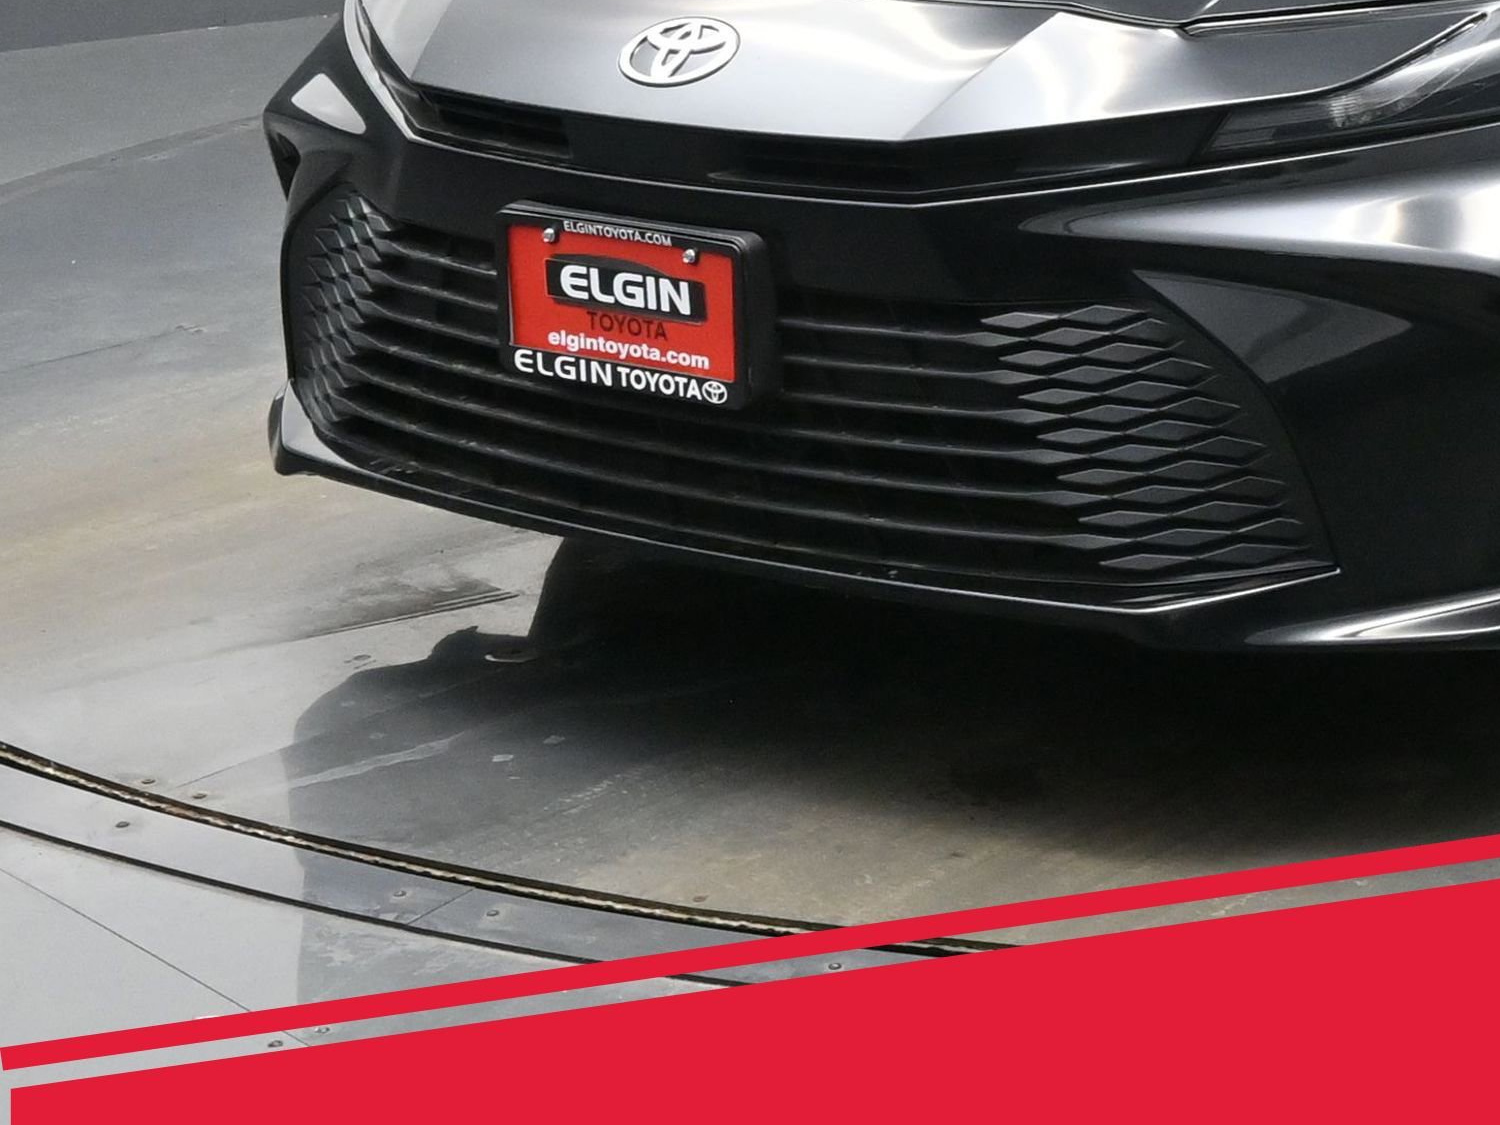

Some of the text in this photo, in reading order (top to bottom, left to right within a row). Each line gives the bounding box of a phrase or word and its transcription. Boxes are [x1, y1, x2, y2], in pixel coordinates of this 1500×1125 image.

[562, 220, 673, 247] ELGINTOYOTA.COM
[559, 264, 692, 316] ELGIN
[586, 310, 668, 341] TOYOTA
[547, 330, 710, 370] elgintoyota.com
[513, 348, 703, 401] ELGIN TOYOTA
